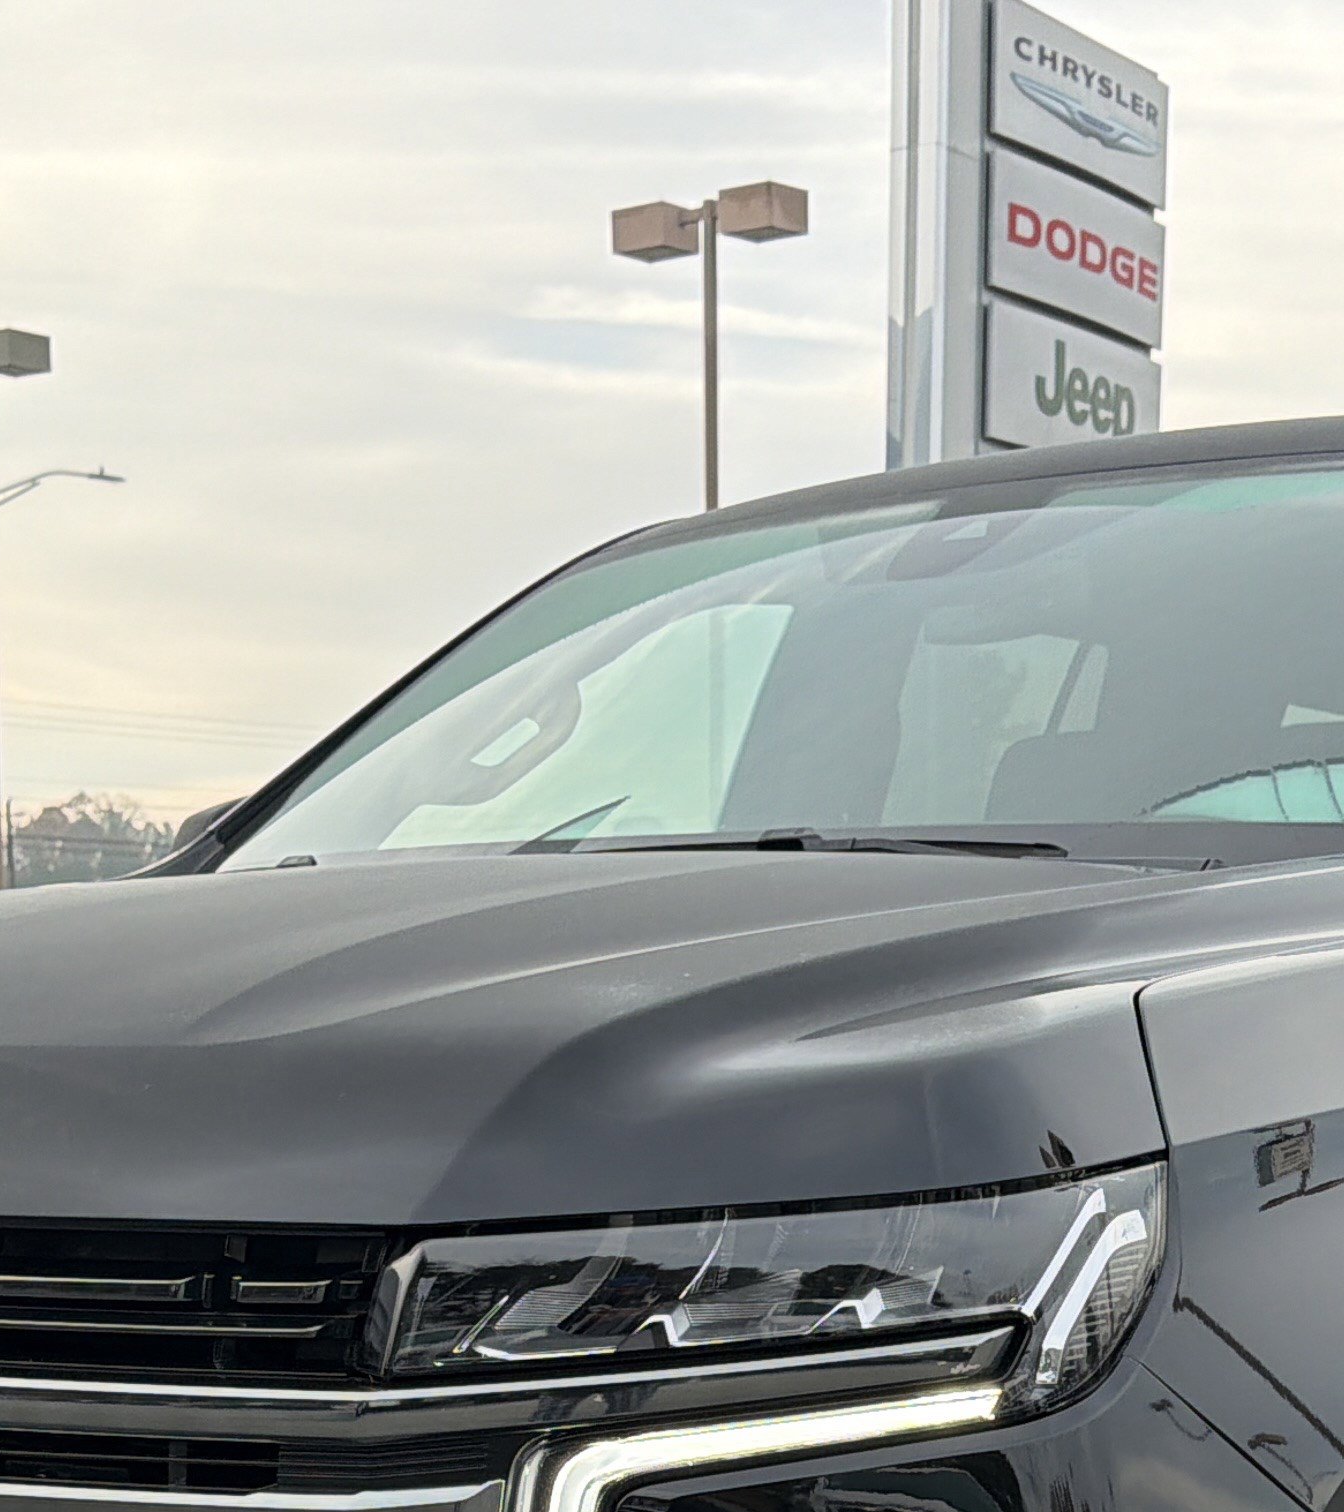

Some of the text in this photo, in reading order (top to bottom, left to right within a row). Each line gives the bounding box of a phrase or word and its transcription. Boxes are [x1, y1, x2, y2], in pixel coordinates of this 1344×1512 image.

[1013, 36, 1158, 127] CHRYSLER
[1007, 202, 1158, 301] DODGE
[1034, 339, 1136, 436] Jeep
